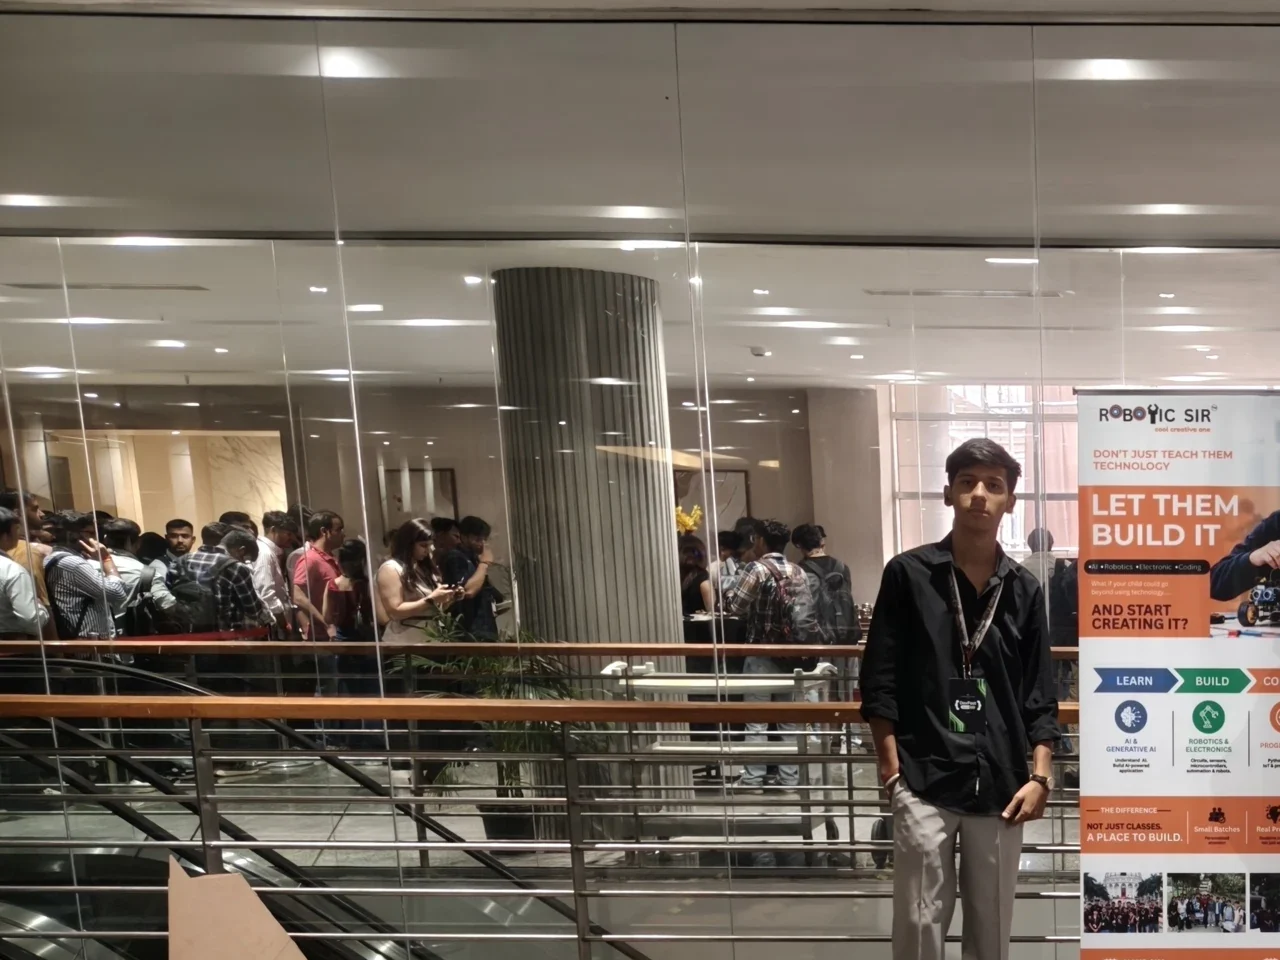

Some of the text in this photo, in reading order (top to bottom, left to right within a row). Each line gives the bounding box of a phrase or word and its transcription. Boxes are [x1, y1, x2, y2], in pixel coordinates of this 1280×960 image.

[1184, 408, 1211, 423] SIR
[1093, 450, 1233, 459] DON'T JUST TEACH THEM
[1093, 462, 1170, 471] TECHNOLOGY
[1092, 494, 1239, 516] LET THEM
[1092, 523, 1221, 546] BUILD IT
[1092, 604, 1172, 616] AND START
[1092, 618, 1189, 630] CREATING IT?
[1116, 676, 1153, 686] LEARN
[1195, 676, 1230, 686] BUILD
[1086, 833, 1183, 842] A PLACE TO BUILD.
